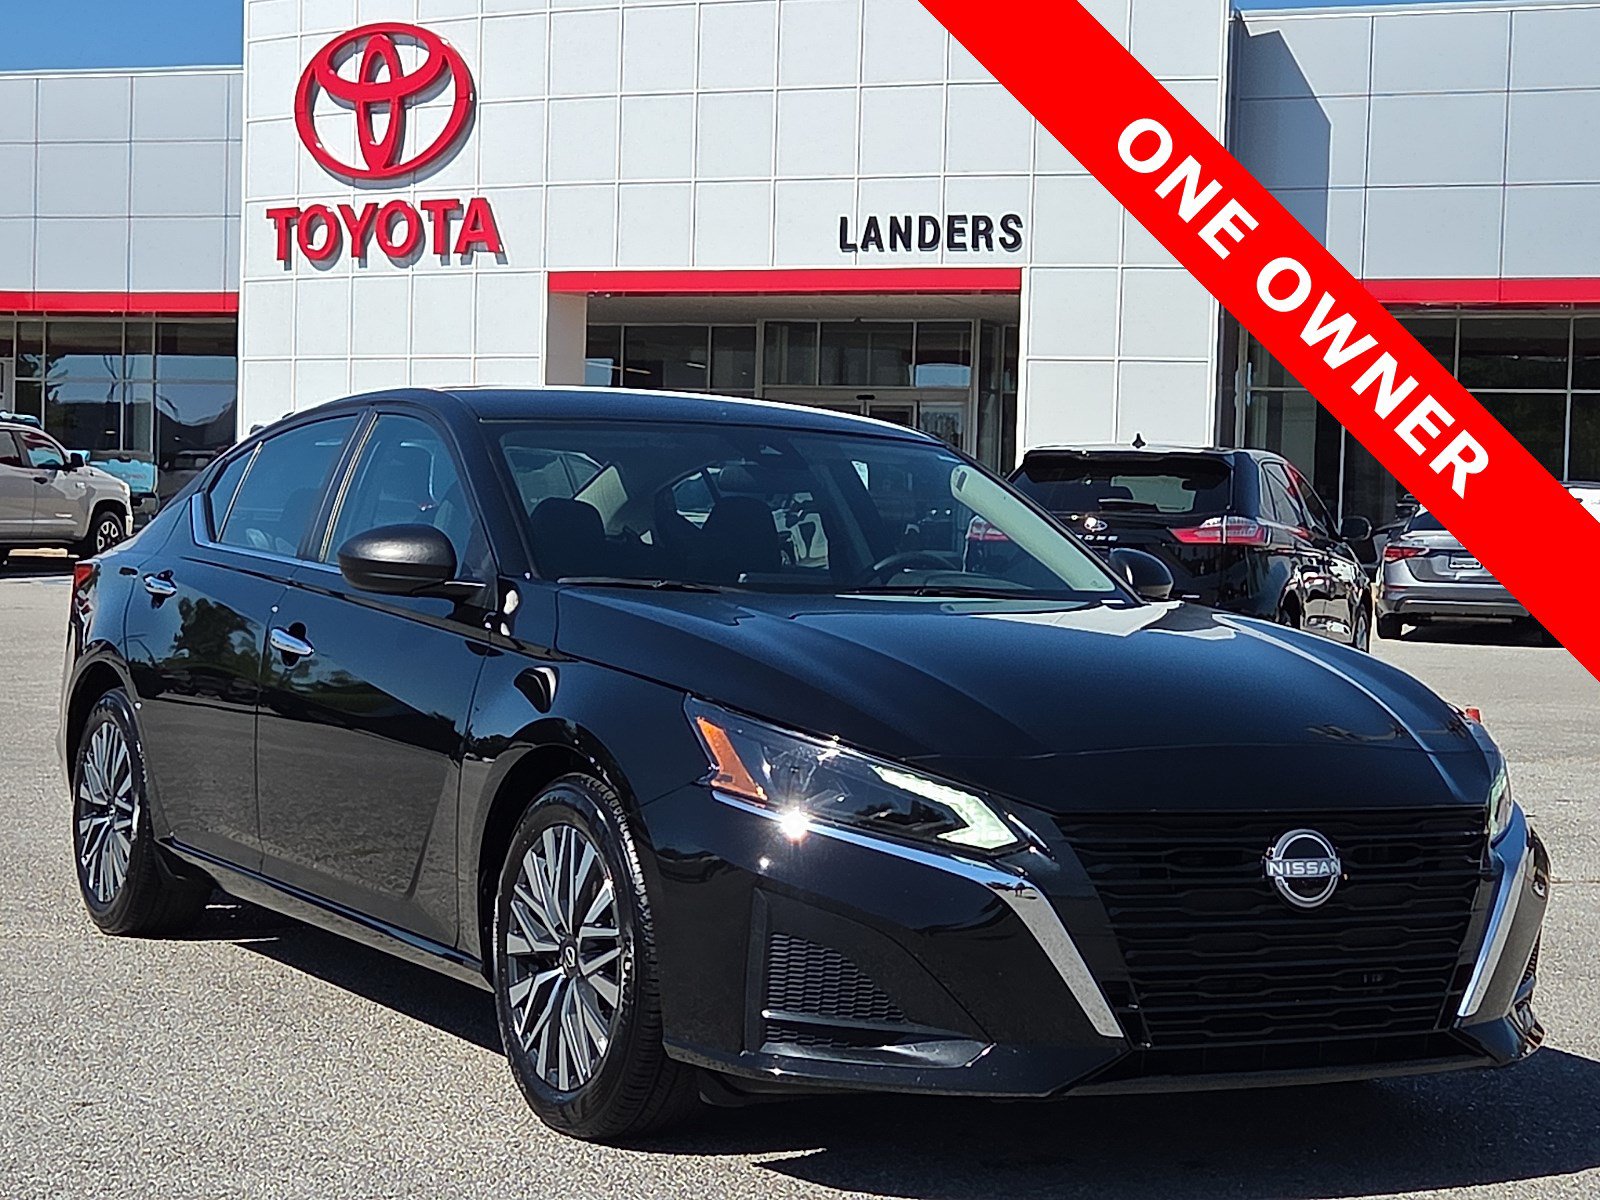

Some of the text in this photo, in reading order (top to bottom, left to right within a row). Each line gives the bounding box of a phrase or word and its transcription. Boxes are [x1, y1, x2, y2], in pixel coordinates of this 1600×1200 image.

[266, 197, 504, 263] TOYOTA
[839, 213, 1024, 252] LANDERS
[1268, 860, 1340, 876] NISSAN
